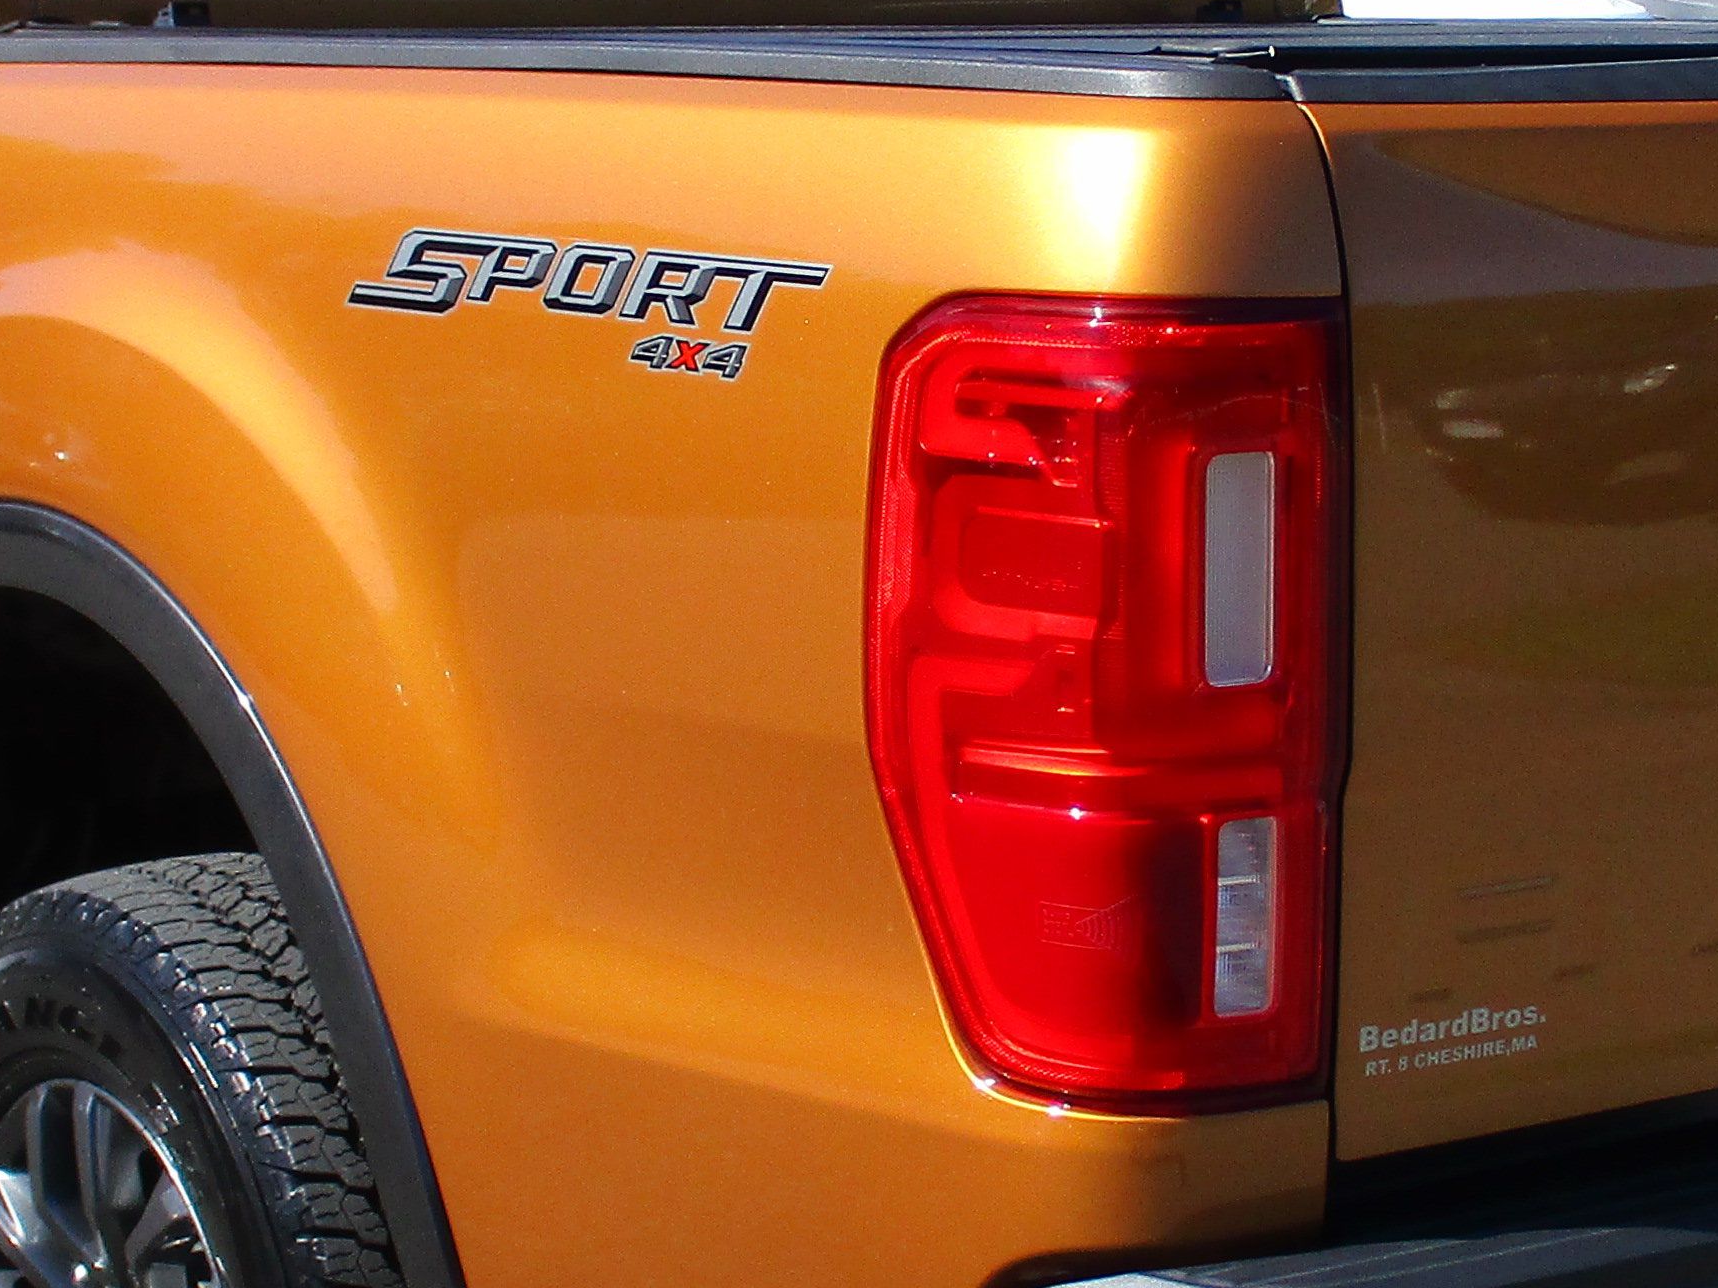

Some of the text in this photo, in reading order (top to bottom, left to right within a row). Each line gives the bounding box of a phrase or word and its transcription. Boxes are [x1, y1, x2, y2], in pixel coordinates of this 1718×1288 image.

[347, 226, 834, 335] SPORT
[1365, 1059, 1393, 1077] RT.
[1397, 1056, 1409, 1072] 8
